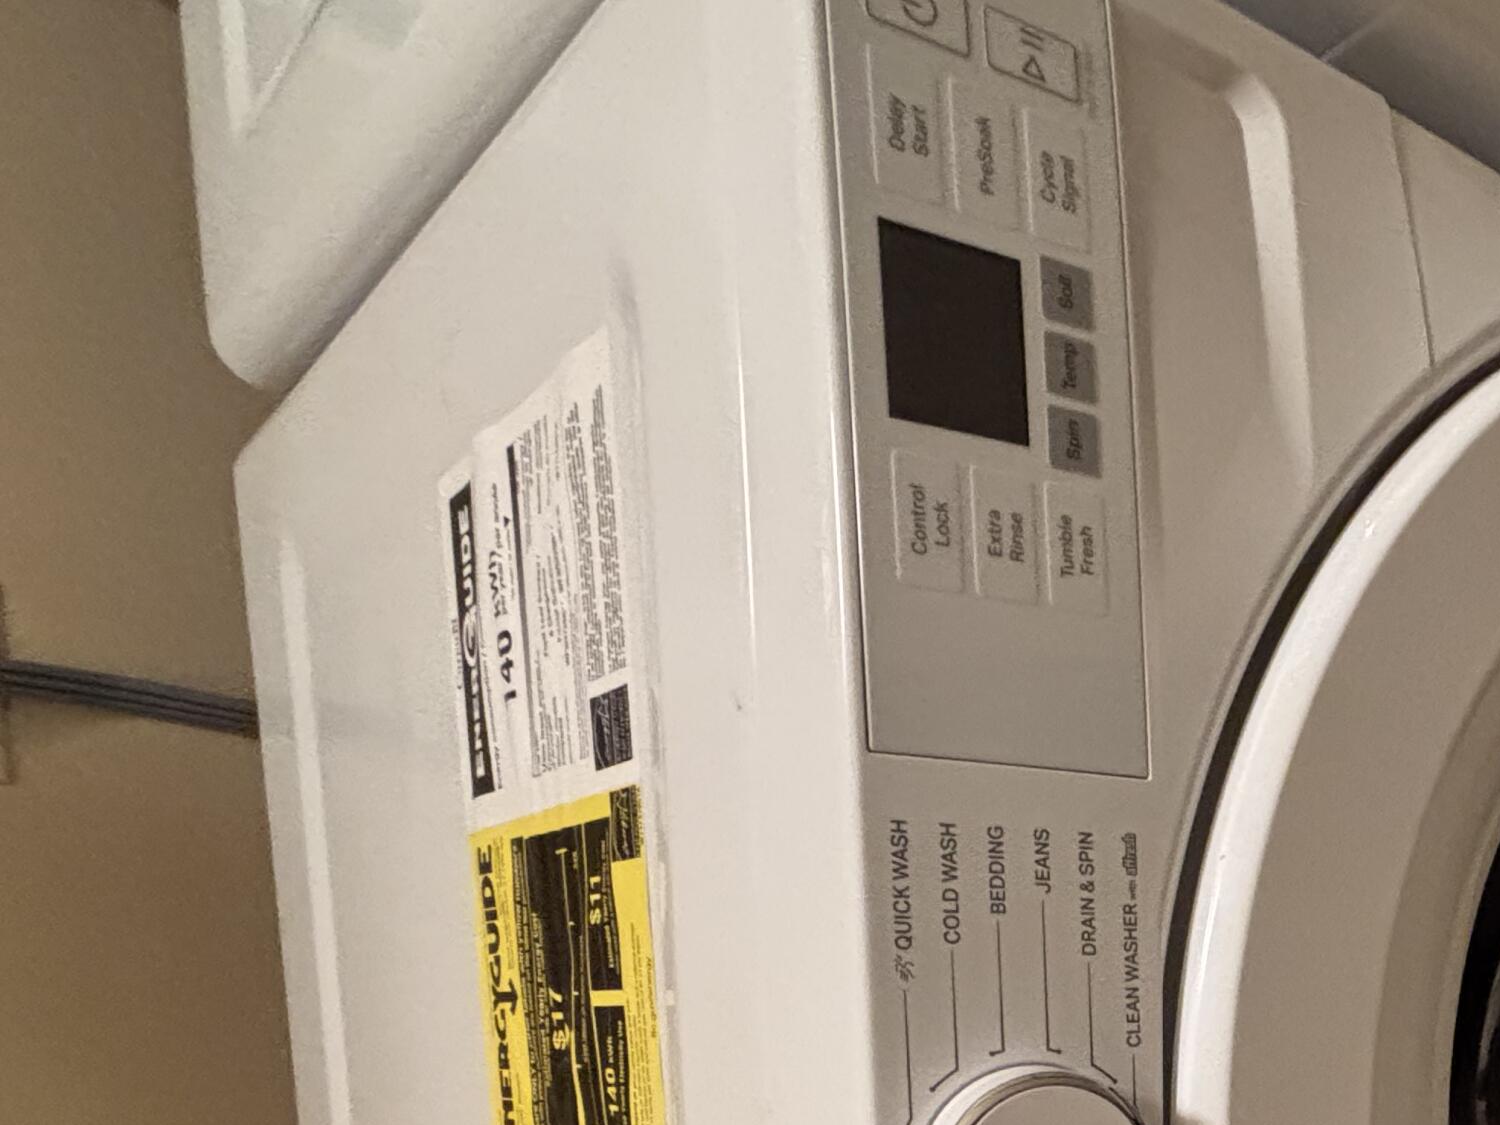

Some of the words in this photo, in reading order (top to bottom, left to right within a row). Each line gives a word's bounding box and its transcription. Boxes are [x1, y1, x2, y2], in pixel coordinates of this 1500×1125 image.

[887, 92, 907, 152] Delay
[911, 105, 929, 158] Start
[974, 116, 994, 196] PreSoak
[1040, 150, 1058, 204] Cycle
[1060, 154, 1080, 214] Signal
[1057, 274, 1074, 309] Soil
[1060, 341, 1079, 390] Temp
[1066, 418, 1083, 460] Spin
[908, 482, 927, 555] Control
[933, 501, 950, 547] Lock
[987, 509, 1003, 557] Extra
[1008, 512, 1024, 563] Rinse
[1058, 513, 1075, 578] Tumble
[1079, 525, 1095, 575] Fresh
[497, 630, 517, 702] 140
[890, 819, 909, 881] WASH
[939, 822, 958, 883] WASH
[987, 825, 1006, 915] BEDDING
[1033, 828, 1051, 895] JEANS
[1078, 831, 1095, 876] SPIN
[589, 875, 601, 925] $11
[1080, 880, 1095, 893] &
[892, 885, 912, 950] QUICK
[942, 888, 961, 945] COLD
[1080, 897, 1097, 956] DRAIN
[1122, 903, 1139, 982] WASHER
[549, 987, 567, 1049] $17
[1124, 987, 1141, 1048] CLEAN
[605, 1067, 619, 1117] 140
